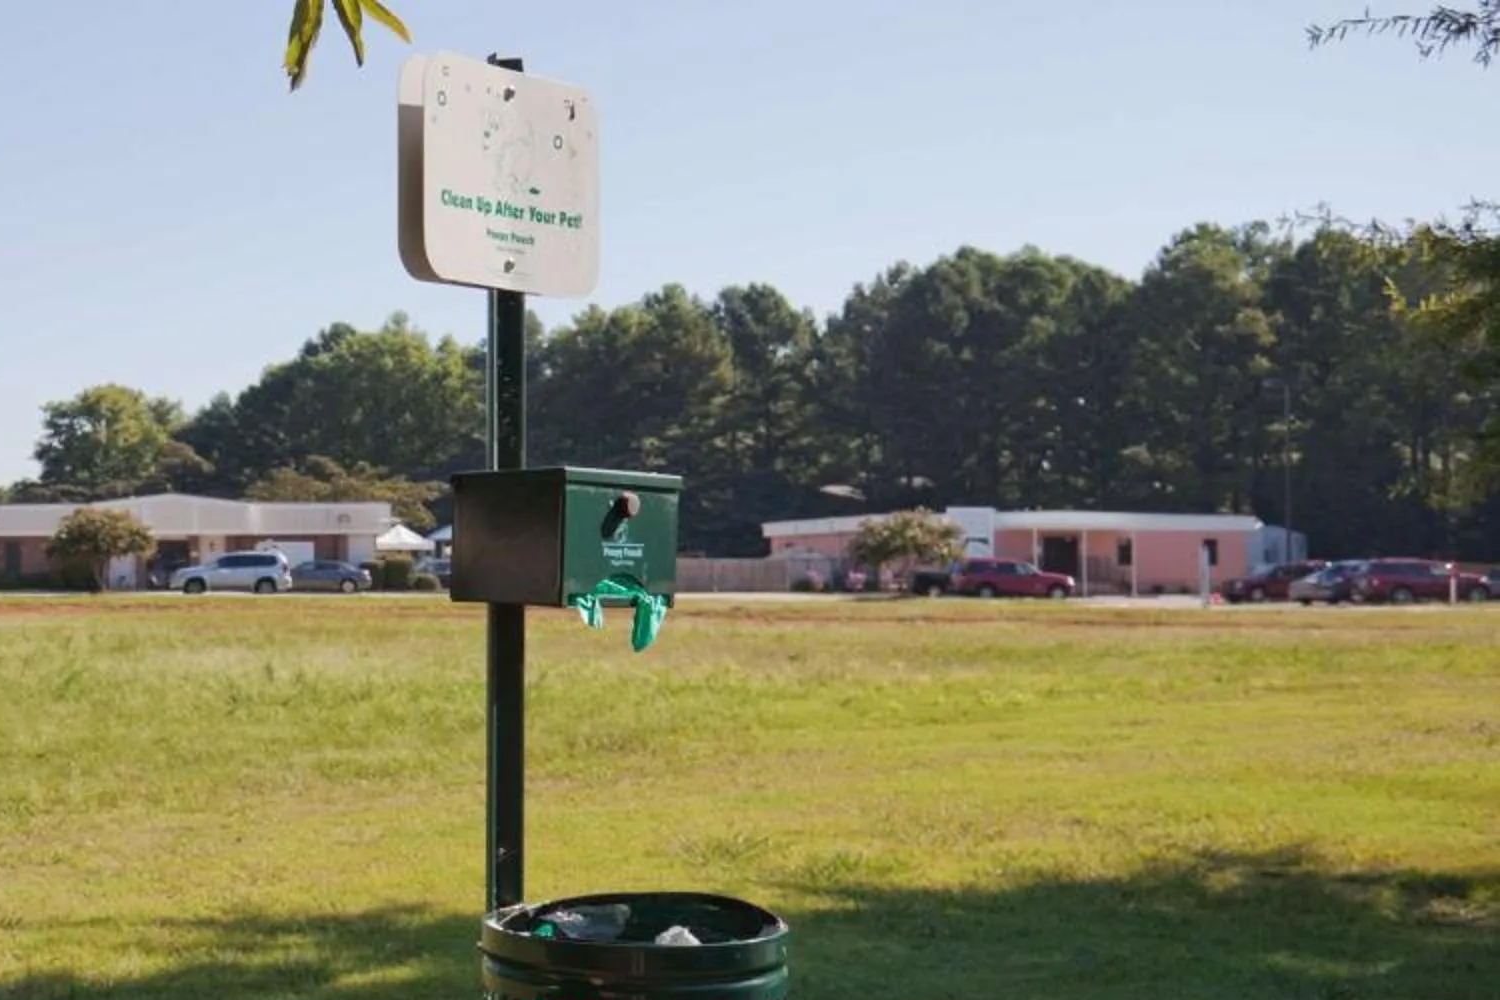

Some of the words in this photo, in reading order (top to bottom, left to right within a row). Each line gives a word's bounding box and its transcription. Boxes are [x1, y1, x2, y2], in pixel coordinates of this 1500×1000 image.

[441, 189, 472, 209] Clean
[476, 196, 492, 216] Up
[495, 200, 524, 220] After
[528, 205, 556, 225] Your
